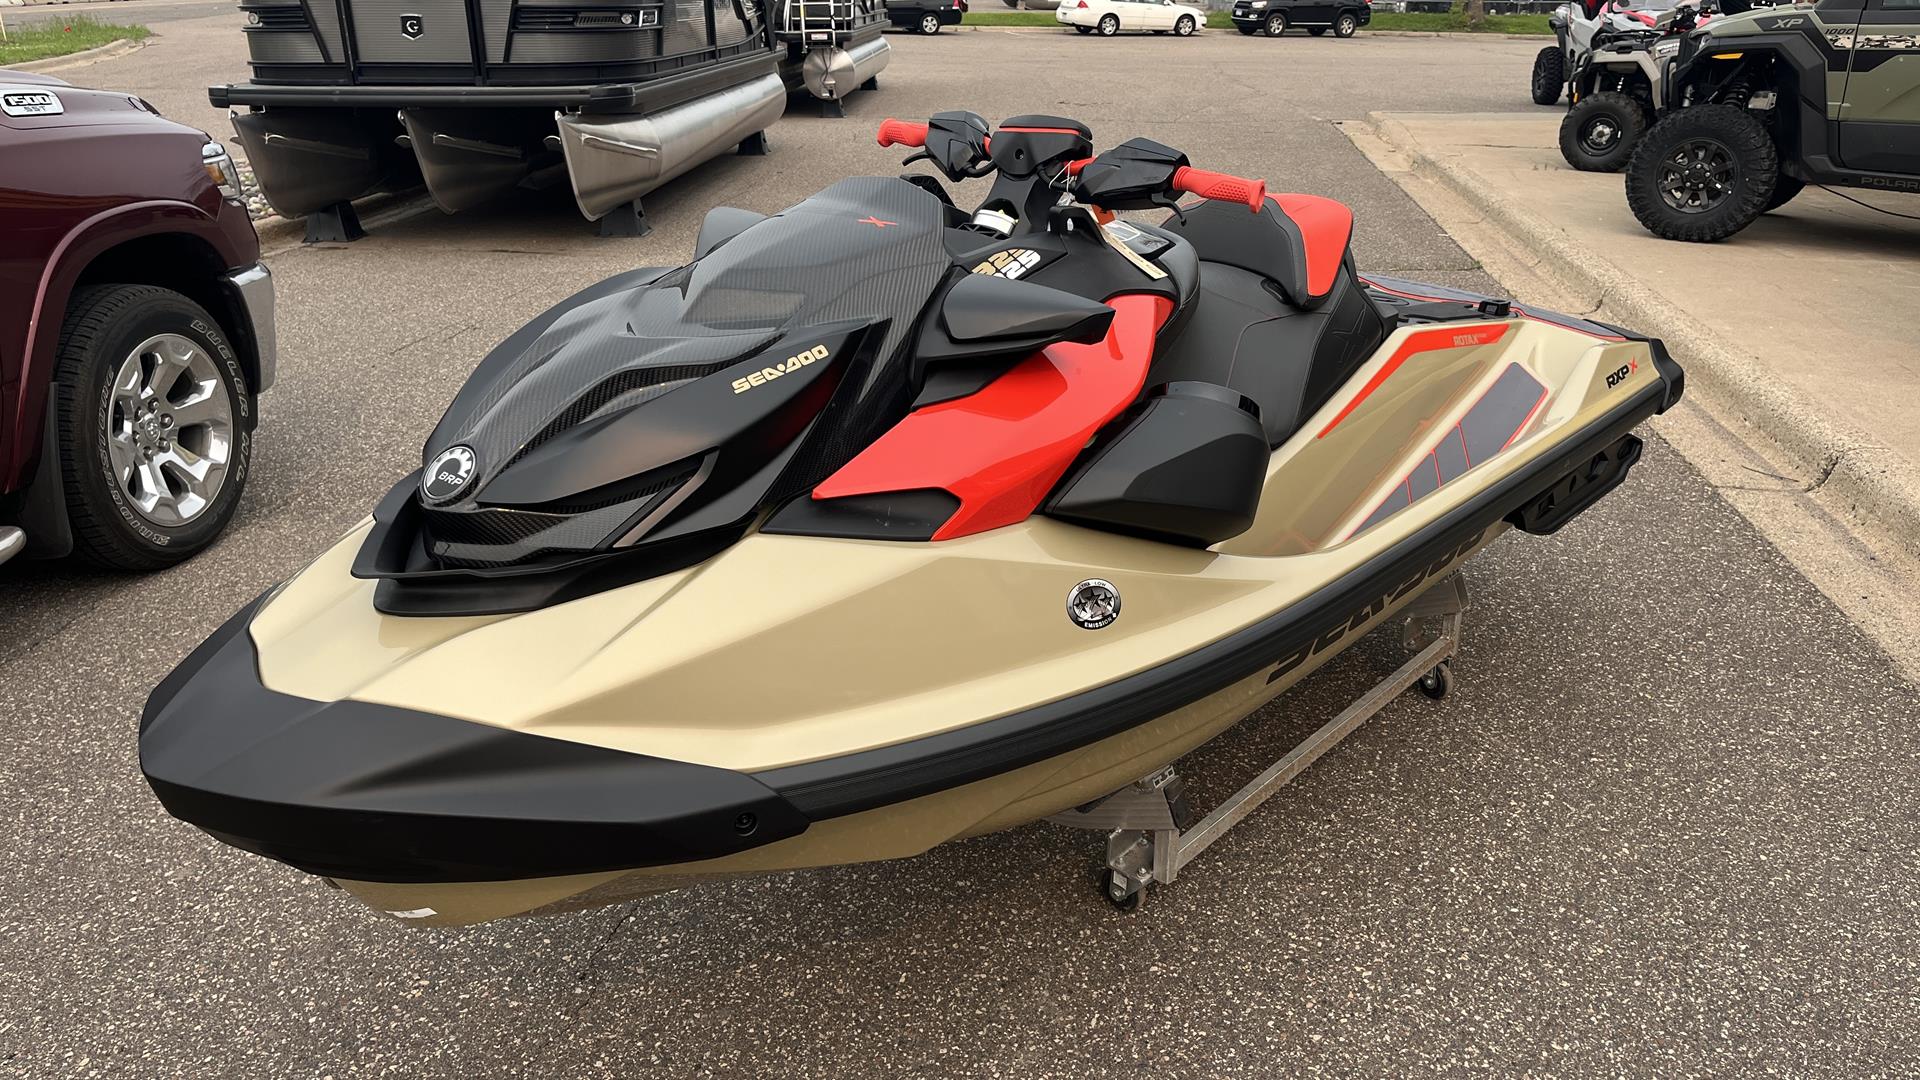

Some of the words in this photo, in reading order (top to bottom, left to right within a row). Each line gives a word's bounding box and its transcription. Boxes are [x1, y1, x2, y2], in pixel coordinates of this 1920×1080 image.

[406, 20, 419, 33] G
[1771, 18, 1804, 29] XP
[4, 93, 52, 106] 1500
[1861, 176, 1920, 189] POLAR
[1453, 333, 1479, 346] ROTAX
[438, 471, 464, 485] BRP
